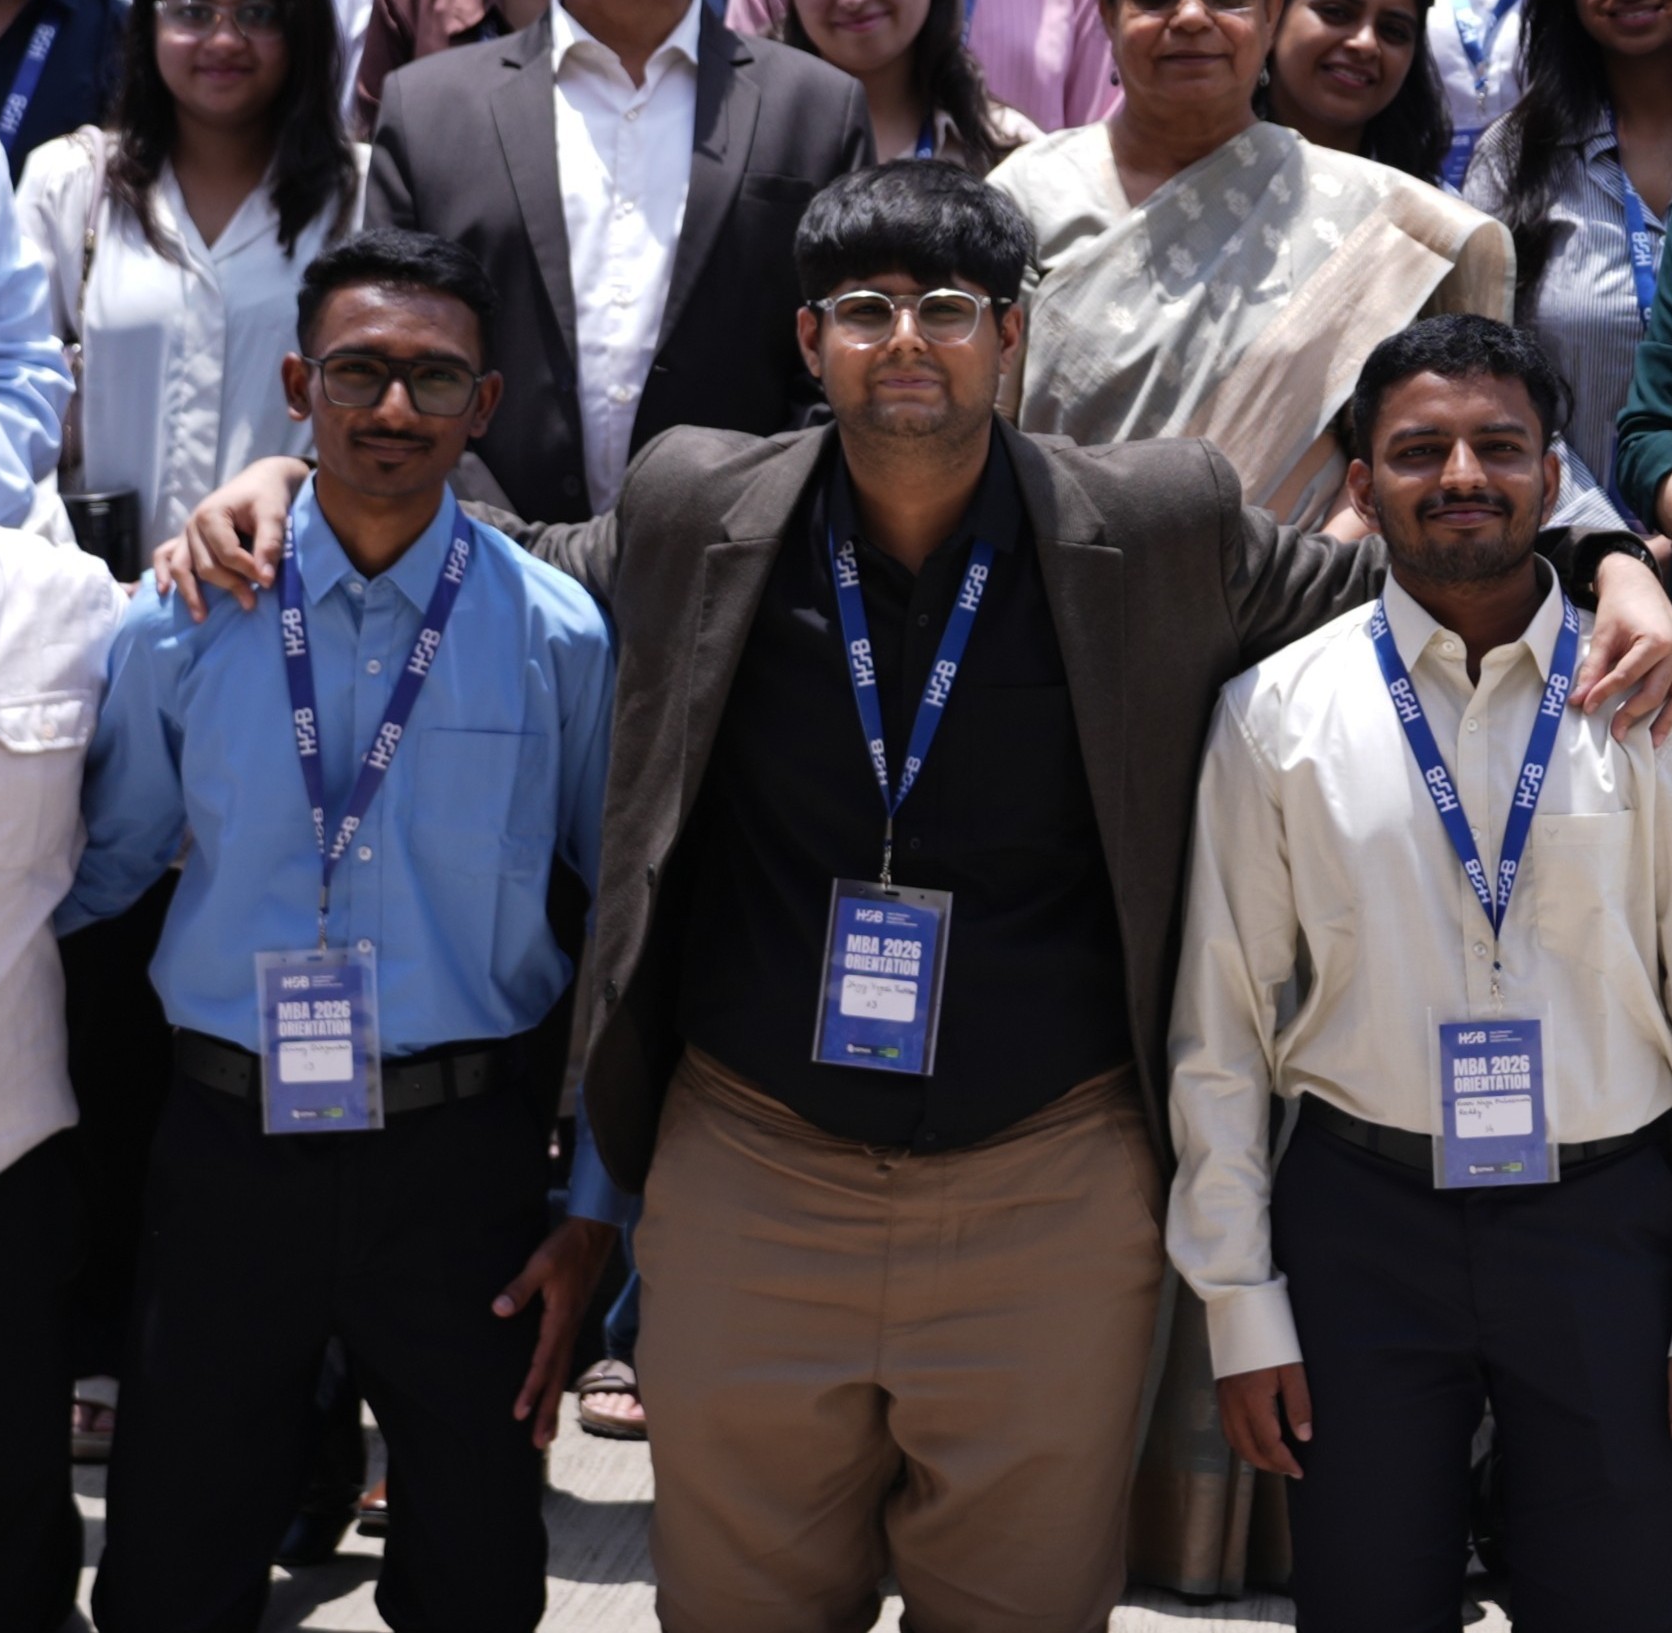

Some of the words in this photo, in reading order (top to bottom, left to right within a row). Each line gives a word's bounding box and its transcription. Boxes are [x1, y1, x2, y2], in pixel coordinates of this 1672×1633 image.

[1631, 231, 1653, 267] HSB
[444, 537, 470, 585] HSB
[959, 563, 989, 613] HSB
[281, 607, 307, 656] HSB
[407, 627, 441, 676] HSB
[849, 638, 876, 688] HSB
[925, 659, 958, 708] HSB
[1389, 676, 1422, 723] HSB
[1540, 672, 1570, 718] HSB
[293, 706, 318, 757] HSB
[367, 720, 404, 770] HSB
[870, 738, 889, 787] HSB
[895, 755, 922, 803] HSB
[1515, 762, 1544, 810] HSB
[1425, 764, 1459, 813] HSB
[329, 815, 361, 861] HSB
[1465, 858, 1491, 905] HSB
[1497, 858, 1517, 907] HSB
[855, 908, 884, 923] HSB
[845, 953, 920, 977] ORIENTATION
[846, 934, 880, 955] MBA
[883, 938, 922, 960] 2026
[282, 975, 310, 989] HSB
[278, 1002, 311, 1019] MBA
[313, 1000, 351, 1019] 2026
[279, 1019, 352, 1037] ORIENTATION
[1458, 1031, 1486, 1045] HSB
[1453, 1057, 1487, 1076] MBA
[1491, 1055, 1530, 1074] 2026
[1454, 1073, 1531, 1093] ORIENTATION
